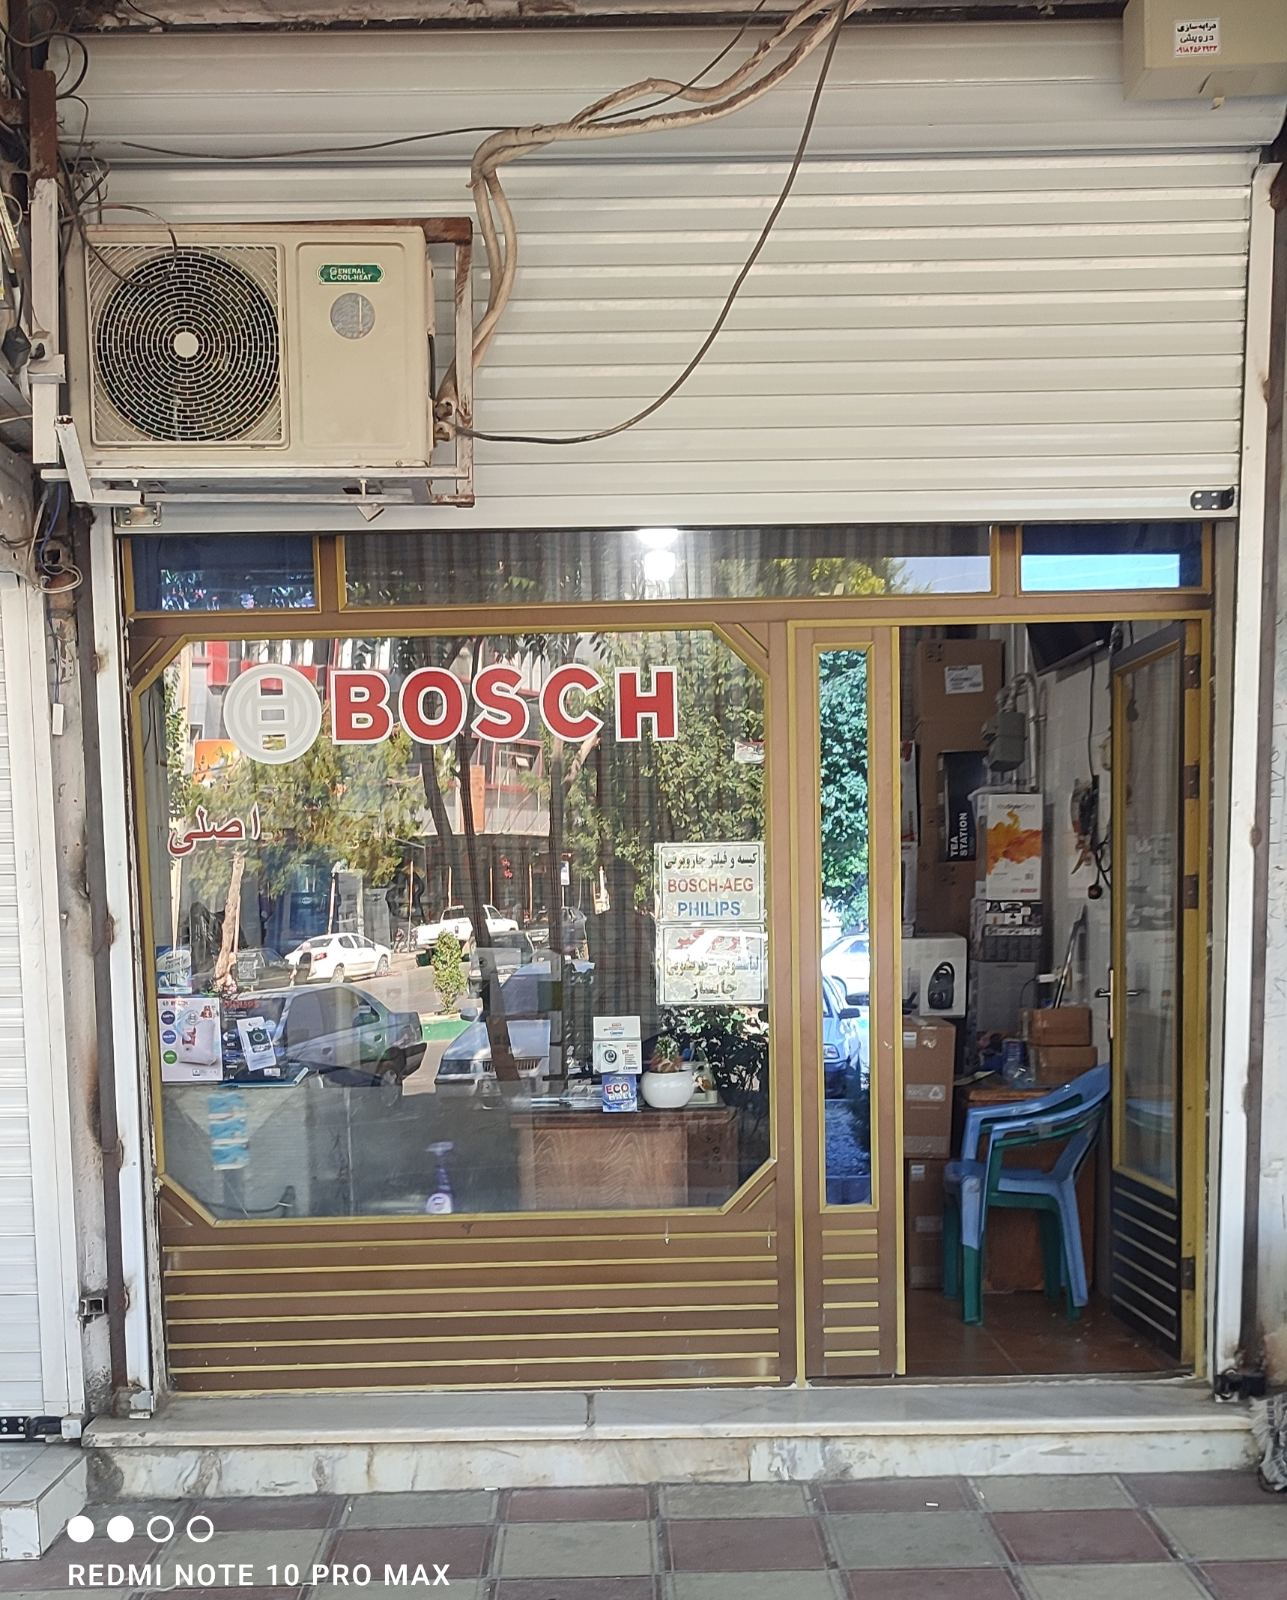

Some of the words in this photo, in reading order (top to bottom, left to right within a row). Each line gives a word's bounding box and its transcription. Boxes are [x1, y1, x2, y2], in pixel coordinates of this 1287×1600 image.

[330, 663, 679, 745] BOSCH
[168, 801, 262, 857] اصلی
[959, 812, 968, 857] STATION
[950, 835, 959, 857] TEA
[708, 850, 728, 868] فیلتر
[730, 857, 735, 868] و
[737, 852, 758, 867] کیسه
[667, 877, 754, 893] BOSCH-AEG
[677, 901, 741, 917] PHILIPS
[605, 1083, 630, 1095] ECO
